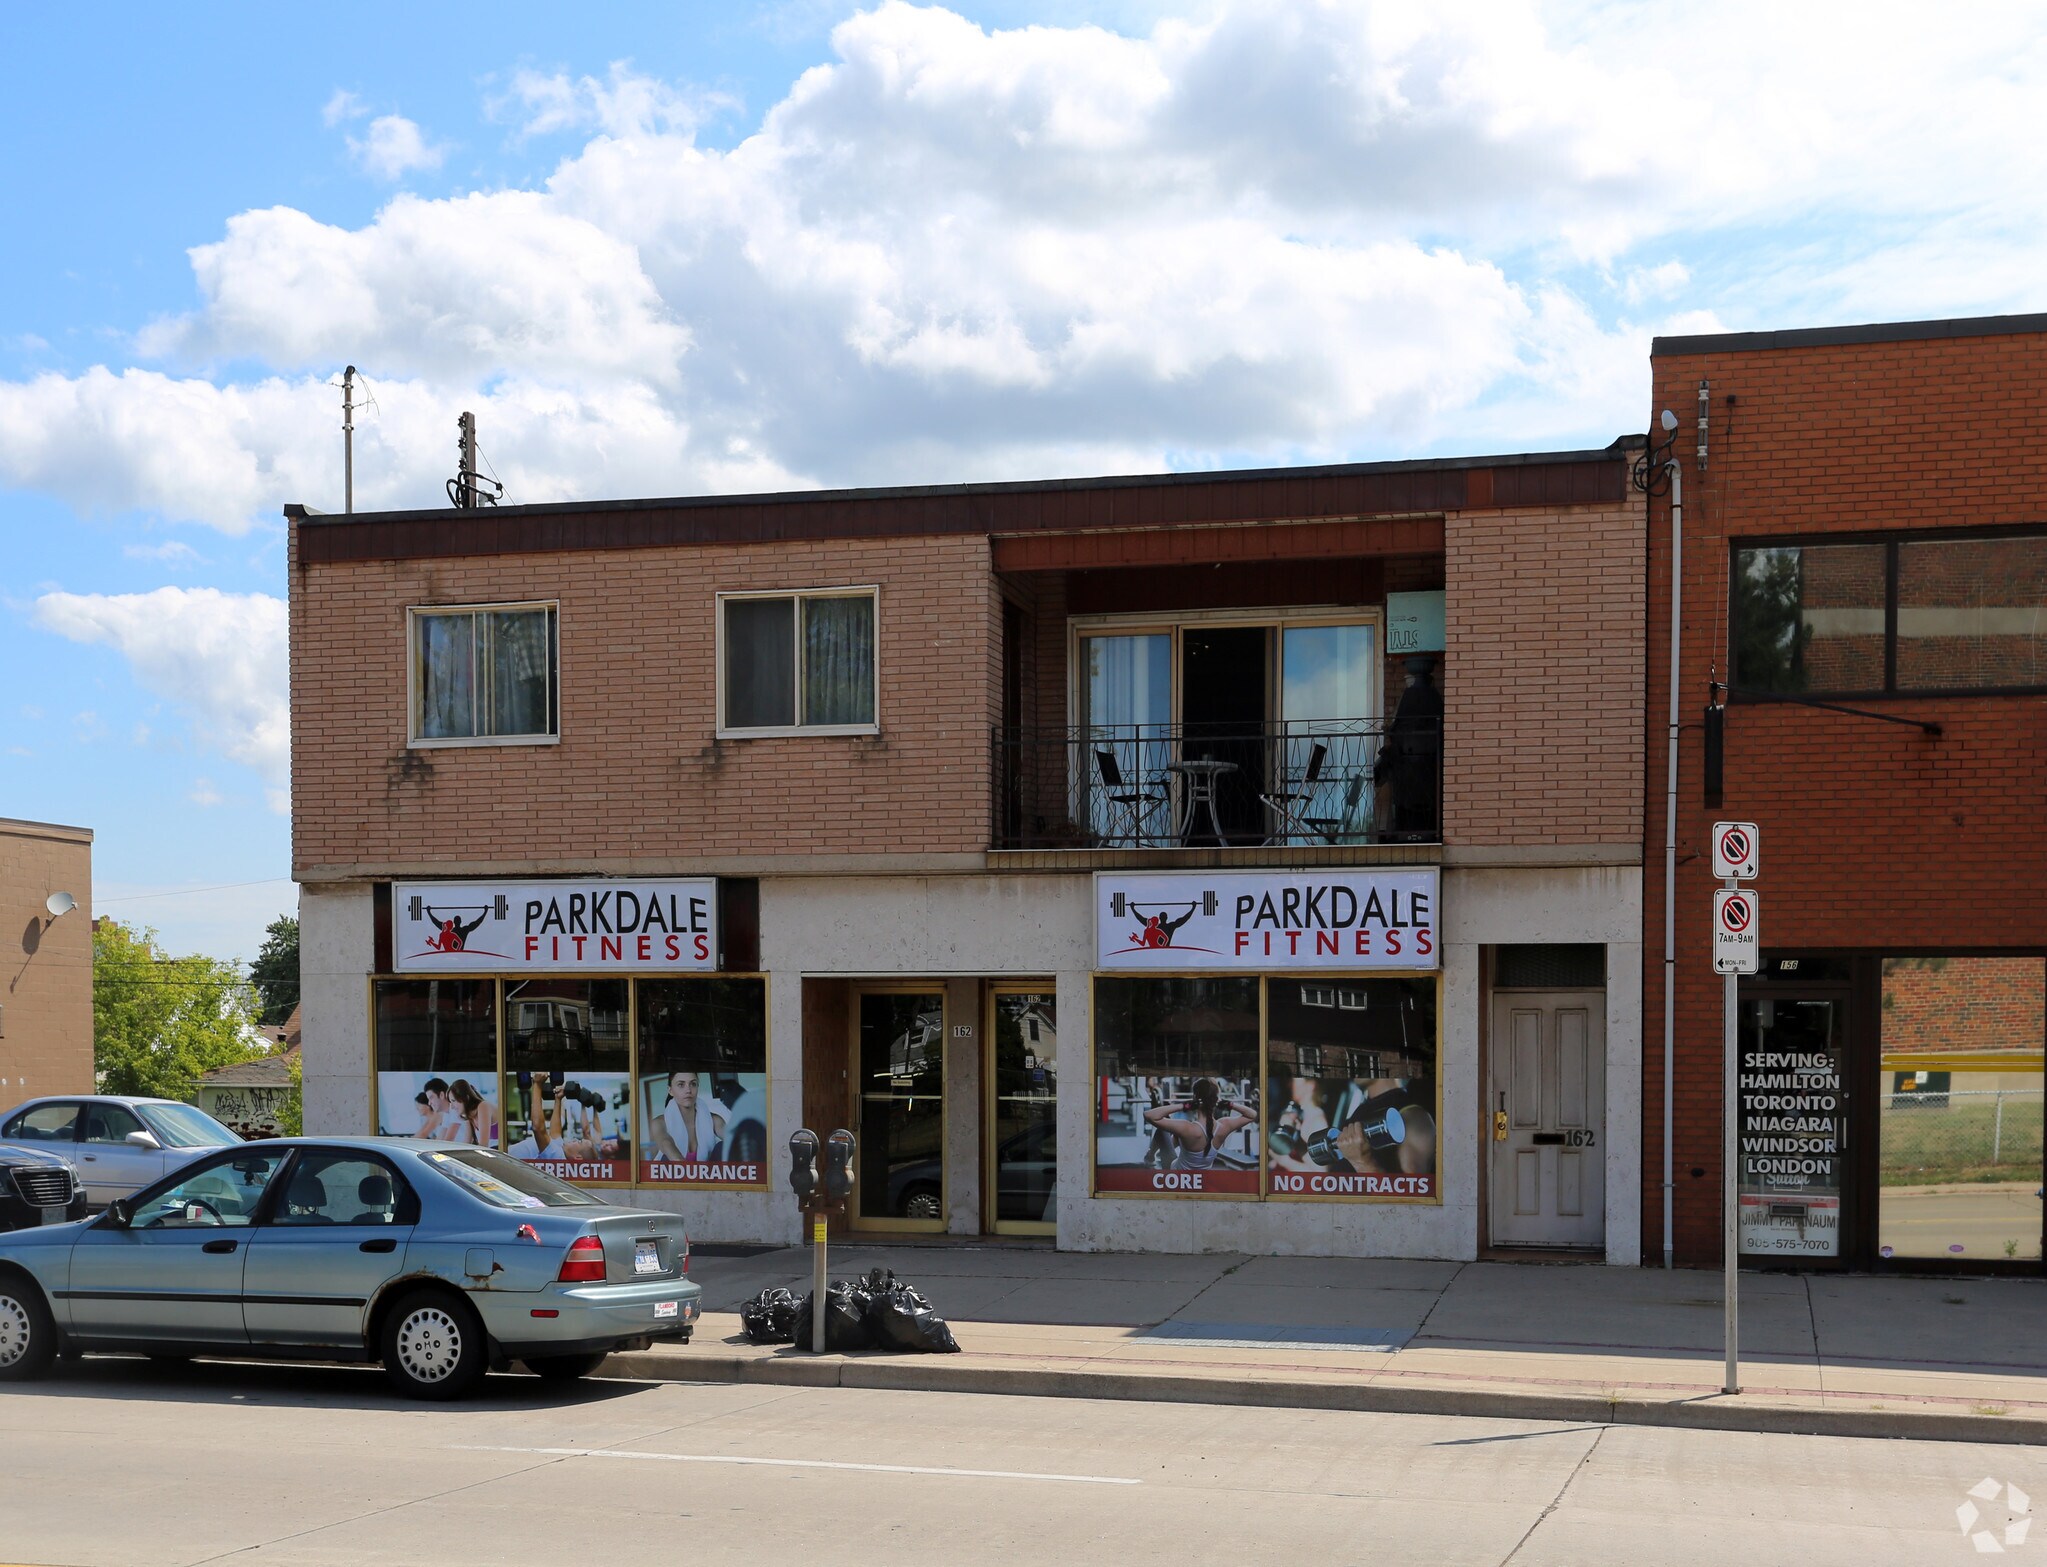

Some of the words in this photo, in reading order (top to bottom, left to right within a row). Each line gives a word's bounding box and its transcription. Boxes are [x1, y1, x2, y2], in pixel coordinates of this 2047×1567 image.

[525, 890, 708, 934] PARKDALE
[1235, 885, 1430, 929] PARKDALE
[1235, 929, 1434, 956] FITNESS
[1719, 932, 1754, 943] 7AM-9AM
[525, 934, 710, 961] FITNESS
[1028, 995, 1041, 1003] 162
[955, 1027, 971, 1037] 162
[1744, 1053, 1835, 1068] SERVING:
[1740, 1074, 1840, 1089] HAMILTON
[1743, 1095, 1836, 1110] TORONTO
[1747, 1117, 1834, 1132] NIAGARA
[1566, 1130, 1595, 1146] 162
[1742, 1137, 1837, 1153] WINDSOR
[529, 1163, 613, 1178] TRENGTH
[650, 1164, 757, 1180] ENDURANCE
[1747, 1159, 1831, 1175] LONDON
[1152, 1173, 1203, 1190] CORE
[1274, 1175, 1304, 1192] NO
[1310, 1175, 1429, 1194] CONTRACTS
[1742, 1213, 1773, 1226] JIMMY
[1747, 1238, 1830, 1250] 905-575-7070
